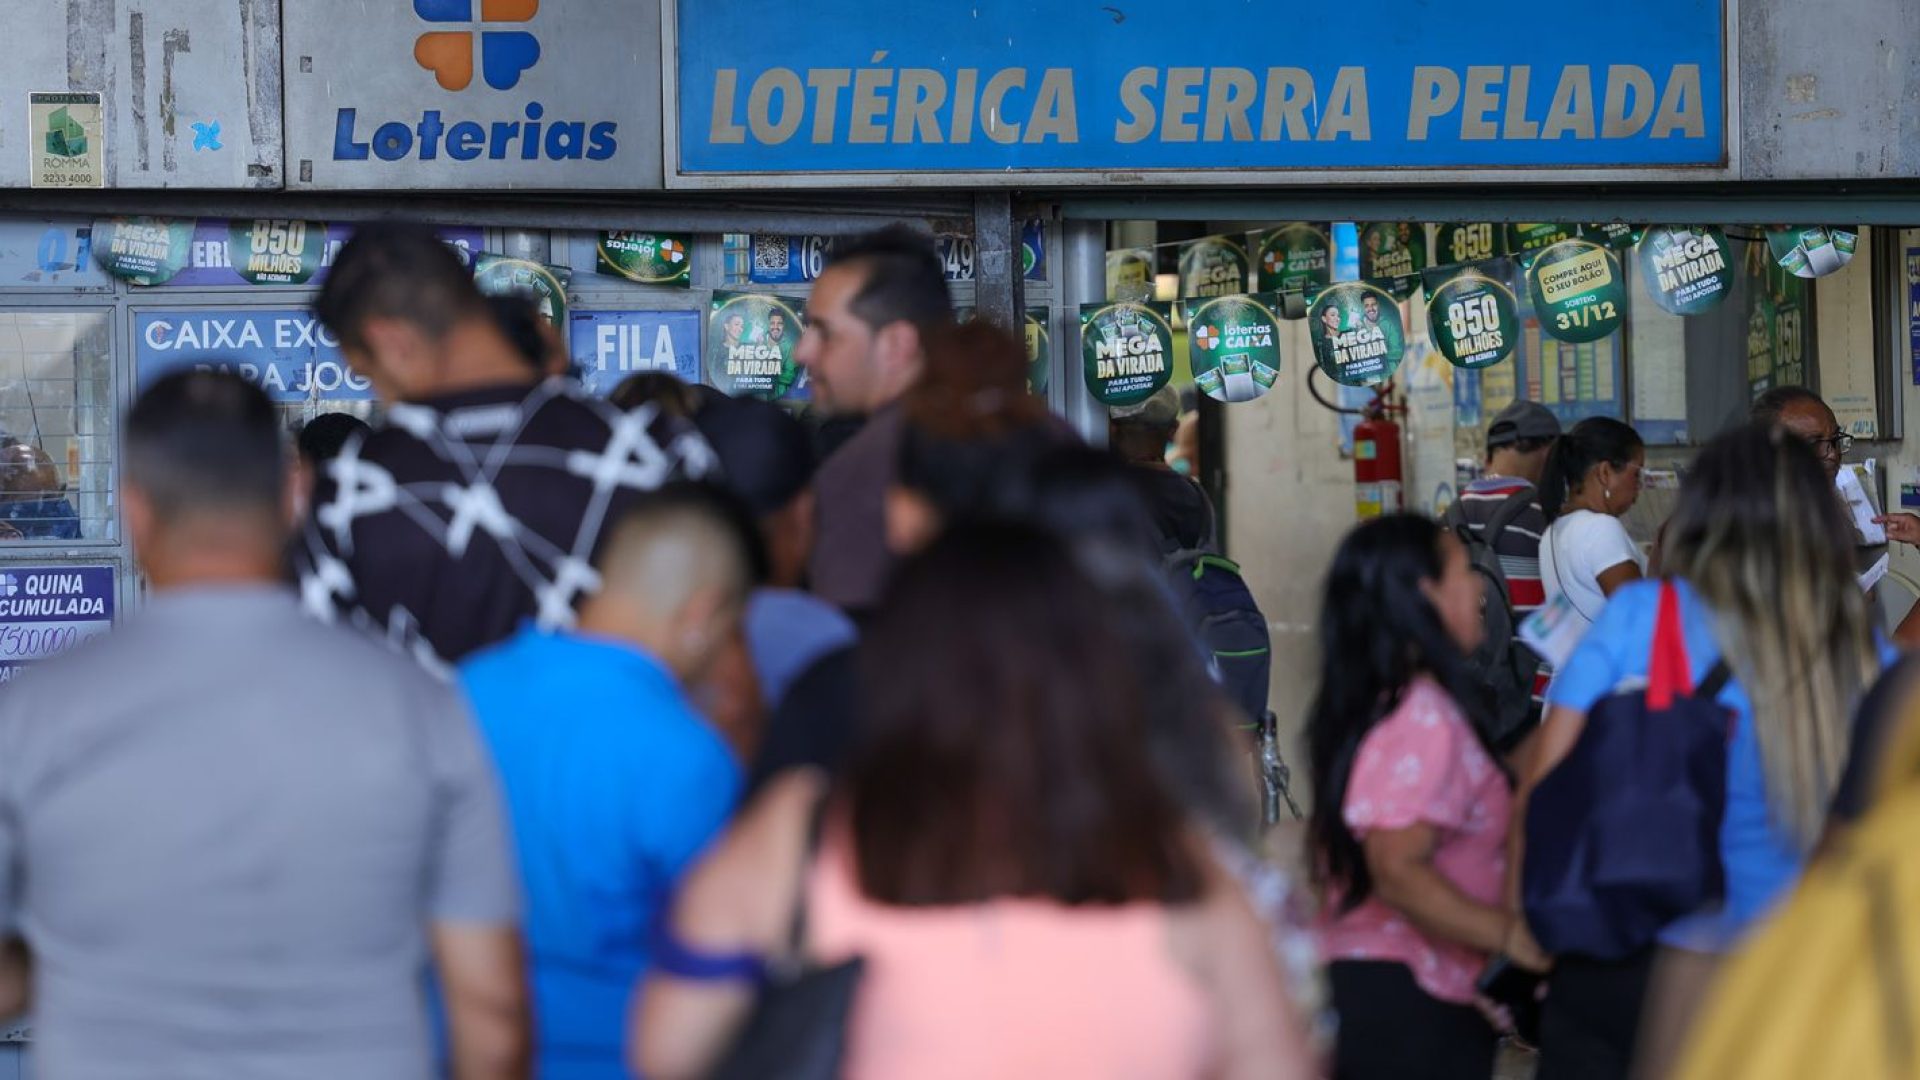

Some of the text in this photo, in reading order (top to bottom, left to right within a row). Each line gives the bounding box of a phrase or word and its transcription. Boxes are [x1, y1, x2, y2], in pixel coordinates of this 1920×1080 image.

[709, 50, 1704, 145] LOTÉRICA SERRA PELADA
[333, 101, 618, 161] Loterias
[43, 158, 90, 168] ROMMA
[43, 174, 92, 183] 3233 4000
[115, 223, 170, 245] MEGA
[251, 219, 306, 256] 850
[112, 238, 168, 260] DA VIRADA
[606, 239, 656, 258] loterias
[1652, 234, 1720, 274] MEGA
[248, 253, 302, 273] MILHÕES
[1543, 260, 1601, 286] COMPRE AQUI
[1658, 251, 1726, 292] DA VIRADA
[1547, 286, 1555, 294] O
[1556, 281, 1571, 292] SEU
[1448, 294, 1500, 340] 850
[1556, 301, 1617, 330] 31/12
[145, 319, 264, 351] CAIXA
[1224, 322, 1271, 336] loterias
[1225, 334, 1272, 348] CAIXA
[1332, 326, 1385, 351] MEGA
[597, 324, 677, 371] FILA
[728, 345, 783, 360] MEGA
[1095, 333, 1164, 359] MEGA
[1334, 340, 1388, 364] DA VIRADA
[1454, 331, 1504, 358] MILHÕES
[727, 360, 781, 375] DA VIRADA
[1097, 353, 1165, 378] DA VIRADA
[25, 574, 83, 596] QUINA
[0, 597, 104, 616] CUMULADA
